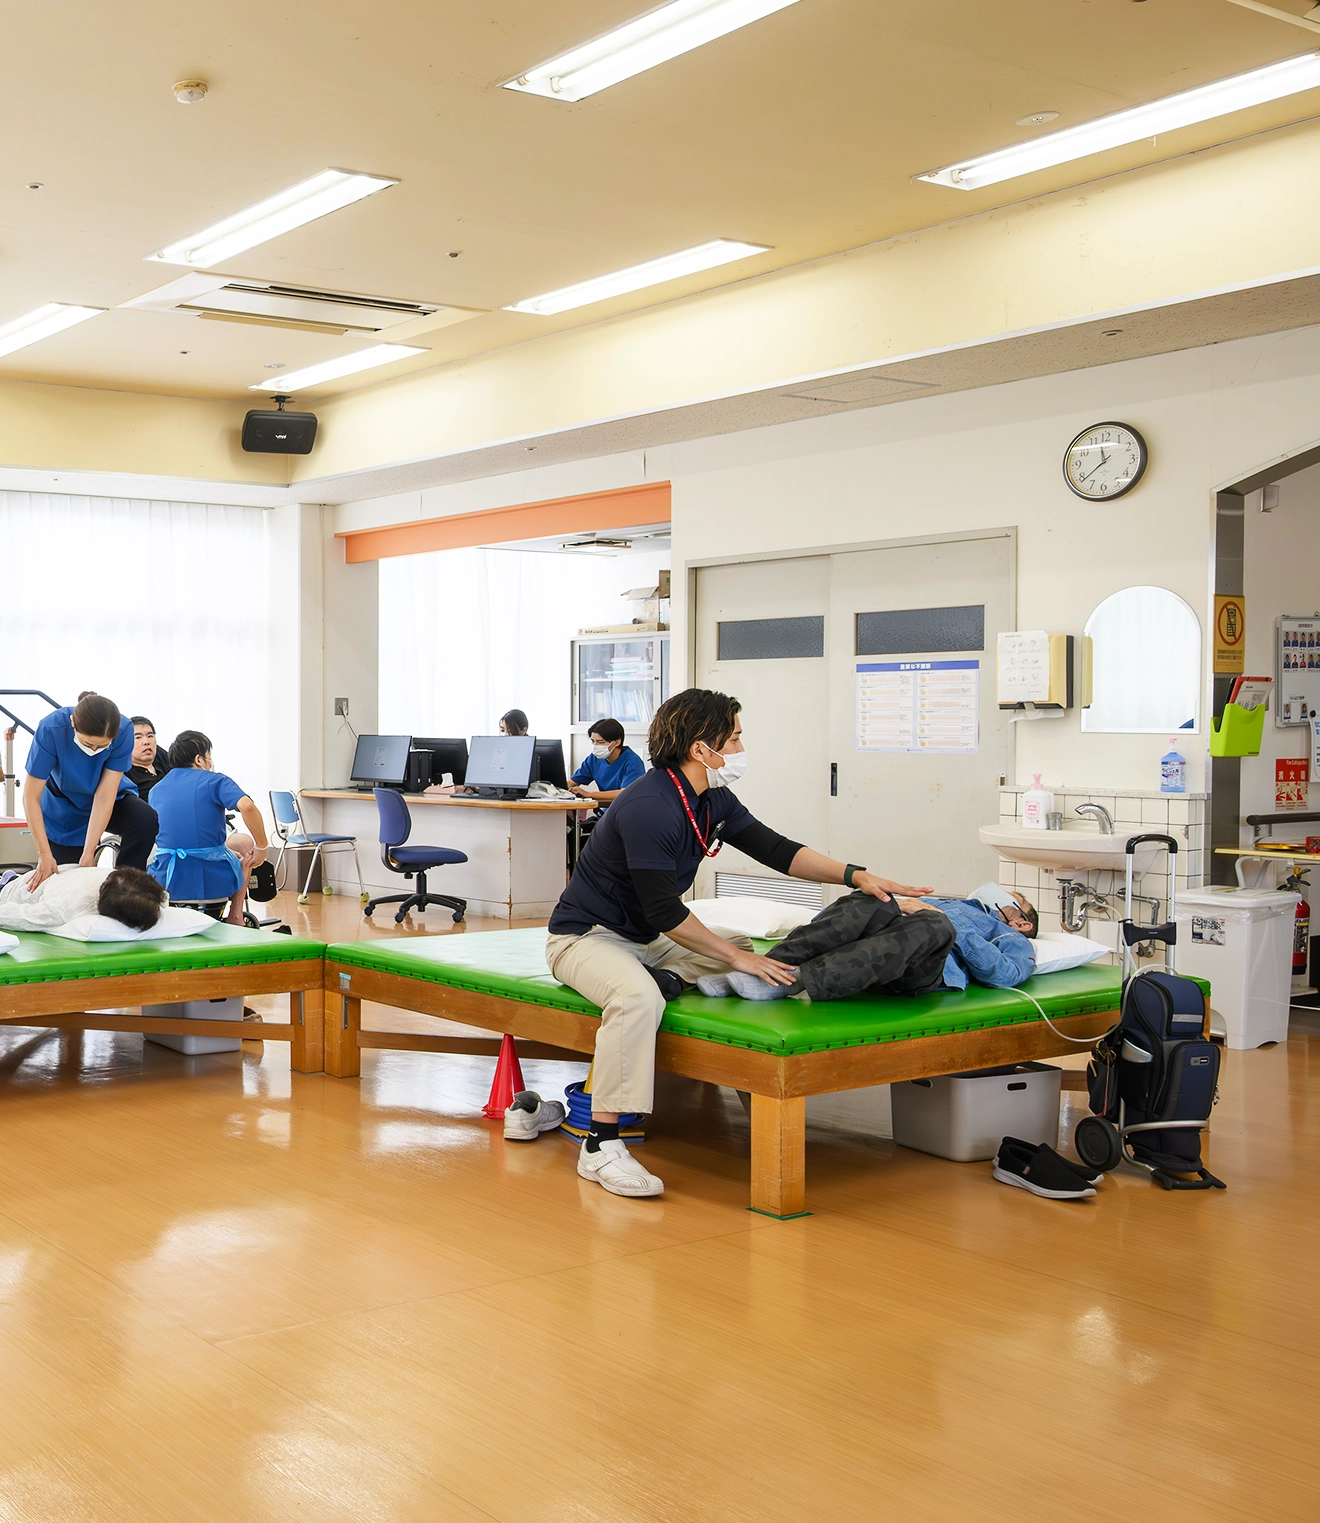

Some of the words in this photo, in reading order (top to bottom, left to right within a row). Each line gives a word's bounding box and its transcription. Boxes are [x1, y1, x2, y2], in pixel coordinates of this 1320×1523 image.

[1090, 437, 1098, 446] 11
[1101, 432, 1111, 442] 12
[1117, 434, 1121, 444] 1
[1125, 441, 1132, 452] 2
[1080, 448, 1090, 457] 10
[1128, 453, 1136, 465] 3
[1074, 460, 1082, 470] 9
[1078, 471, 1086, 482] 8
[1122, 467, 1129, 477] 4
[1089, 479, 1096, 490] 7
[1100, 481, 1107, 491] 6
